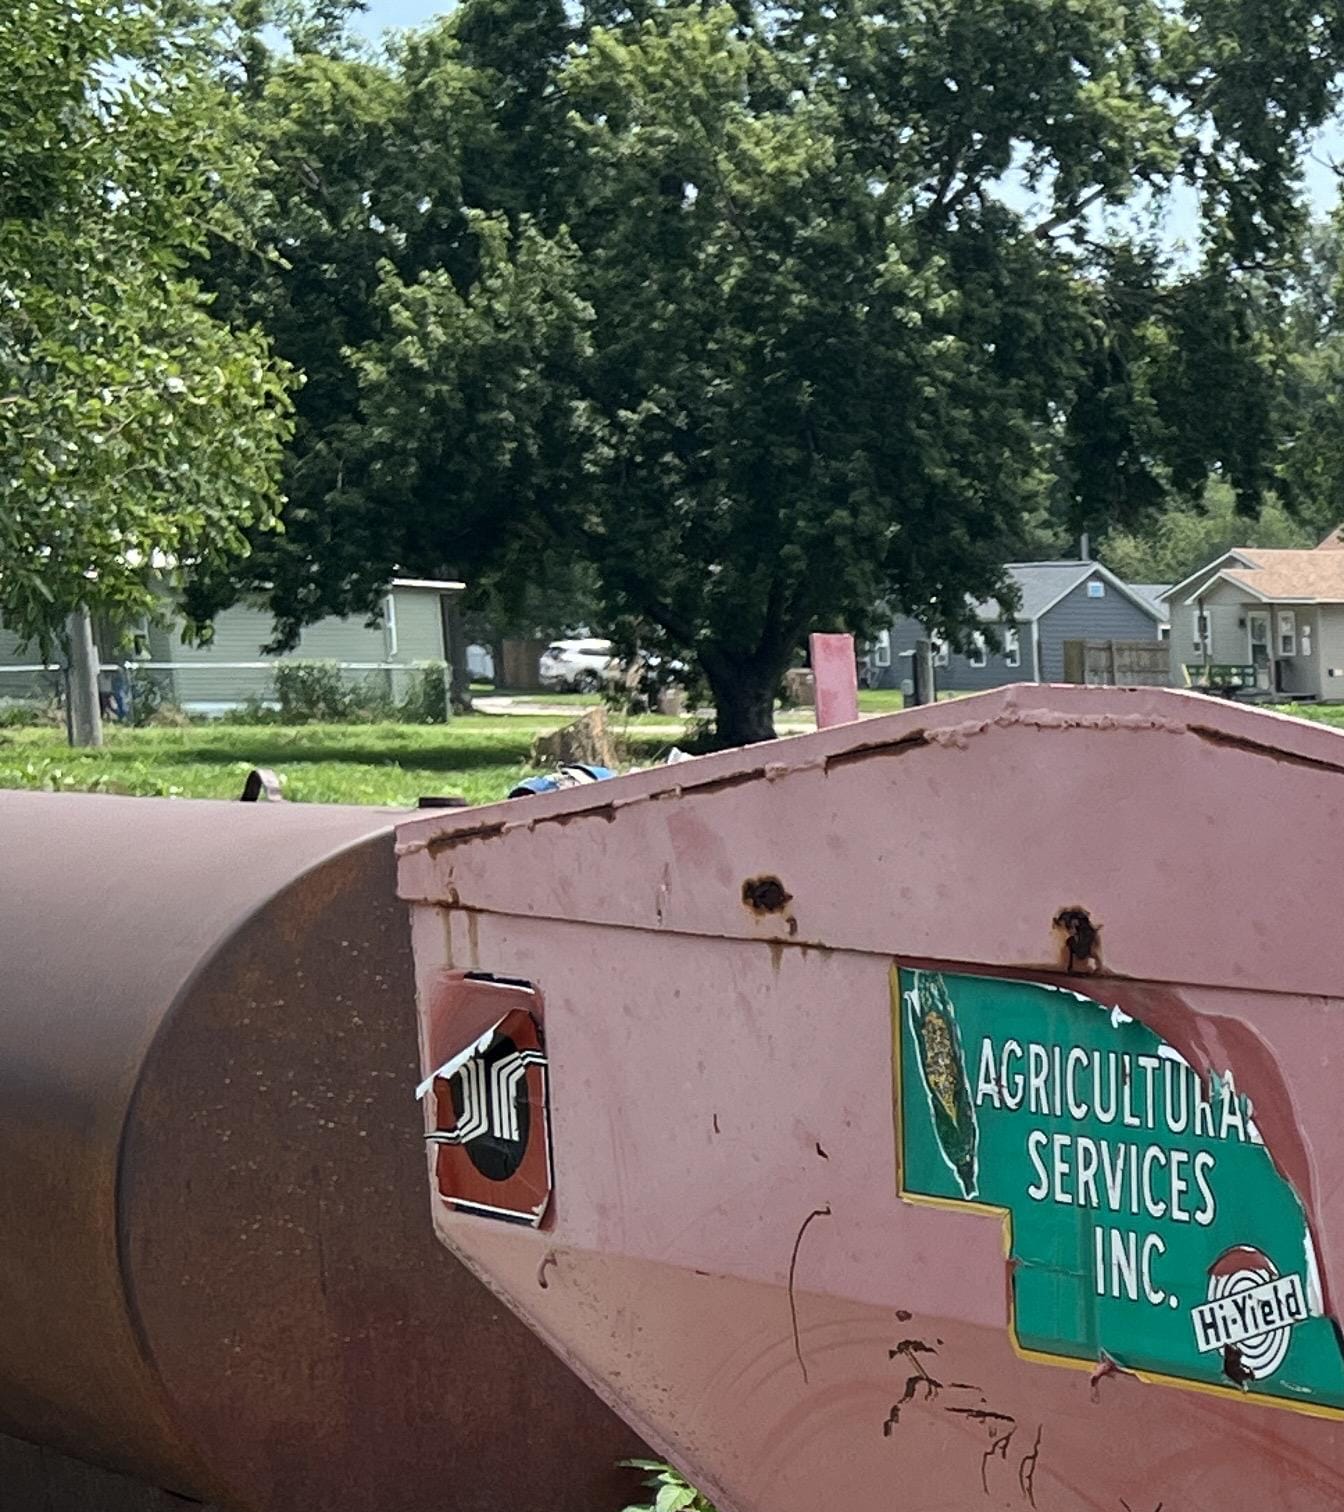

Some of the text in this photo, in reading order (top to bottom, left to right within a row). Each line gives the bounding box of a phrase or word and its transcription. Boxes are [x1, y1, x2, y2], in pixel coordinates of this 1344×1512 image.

[1027, 1130, 1216, 1226] SERVICES
[1095, 1226, 1178, 1309] INC.
[1199, 1276, 1302, 1347] Hi-Yield
